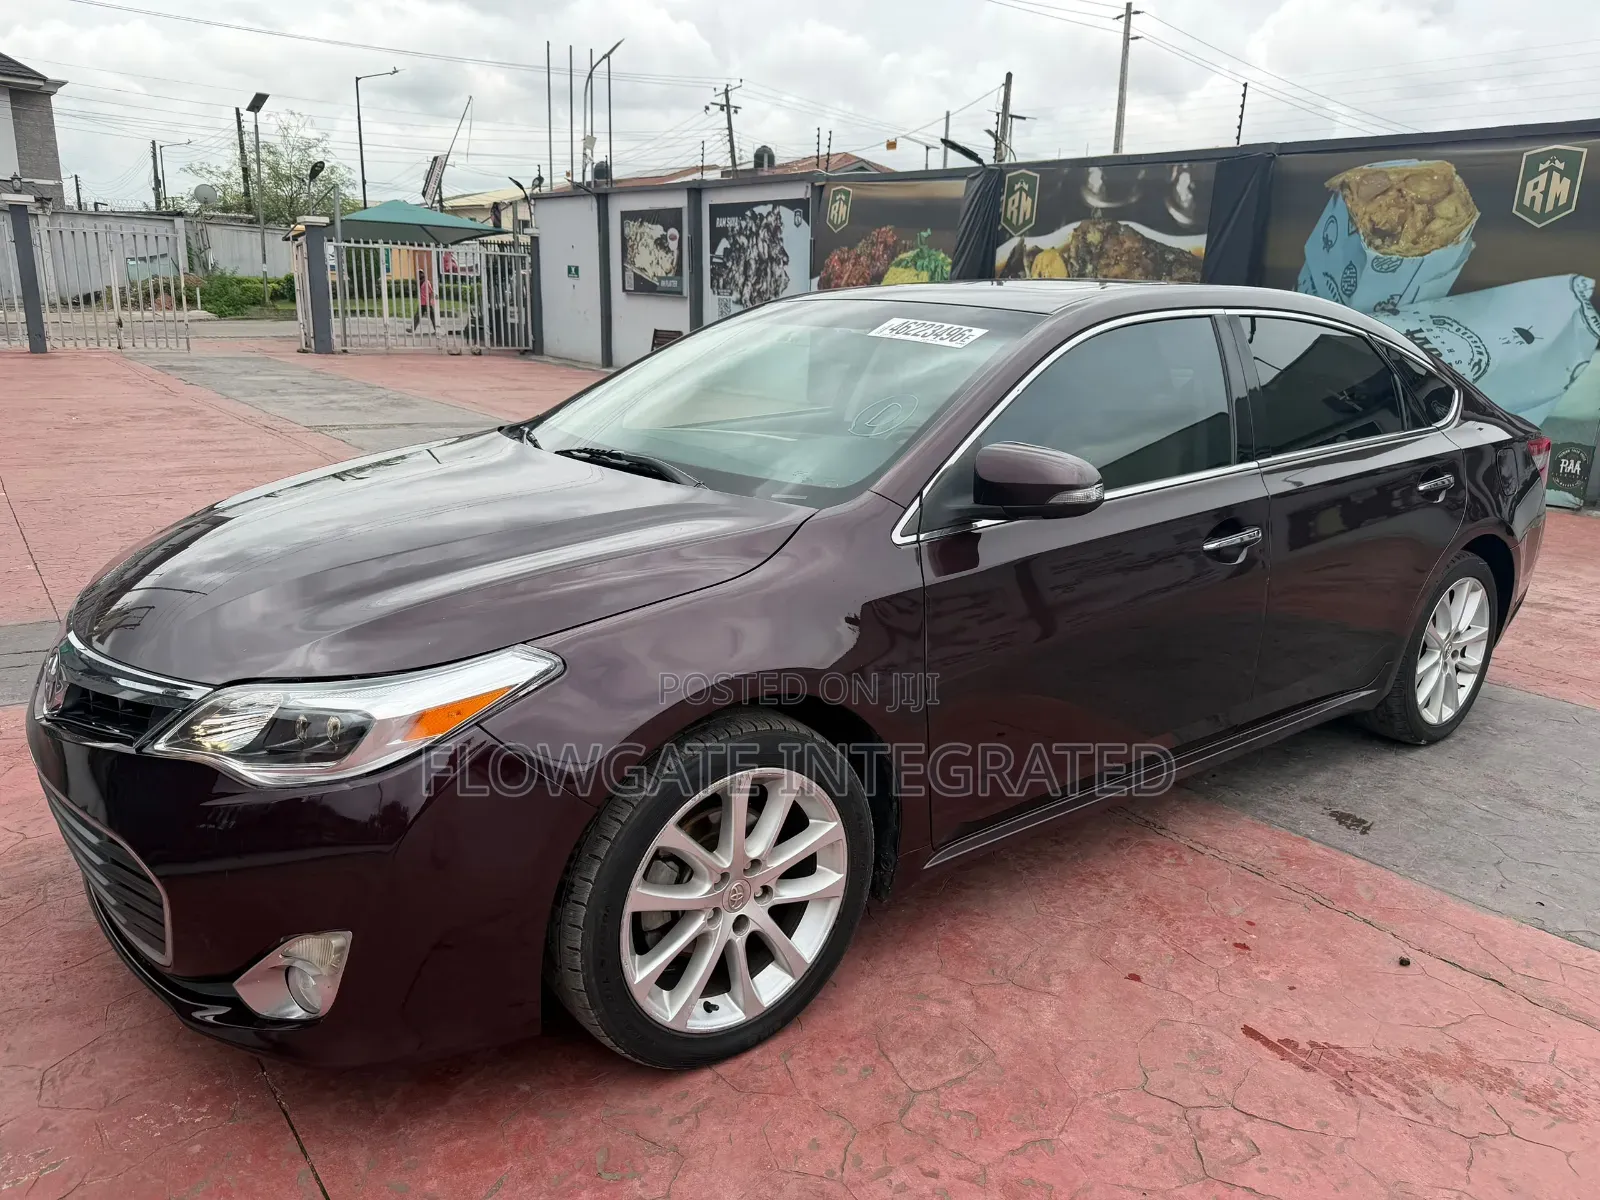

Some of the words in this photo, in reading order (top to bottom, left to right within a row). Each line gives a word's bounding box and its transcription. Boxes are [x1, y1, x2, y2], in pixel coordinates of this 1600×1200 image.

[1523, 170, 1571, 214] RM
[830, 200, 847, 225] RM
[1006, 190, 1032, 226] RM
[888, 320, 974, 343] 46223496
